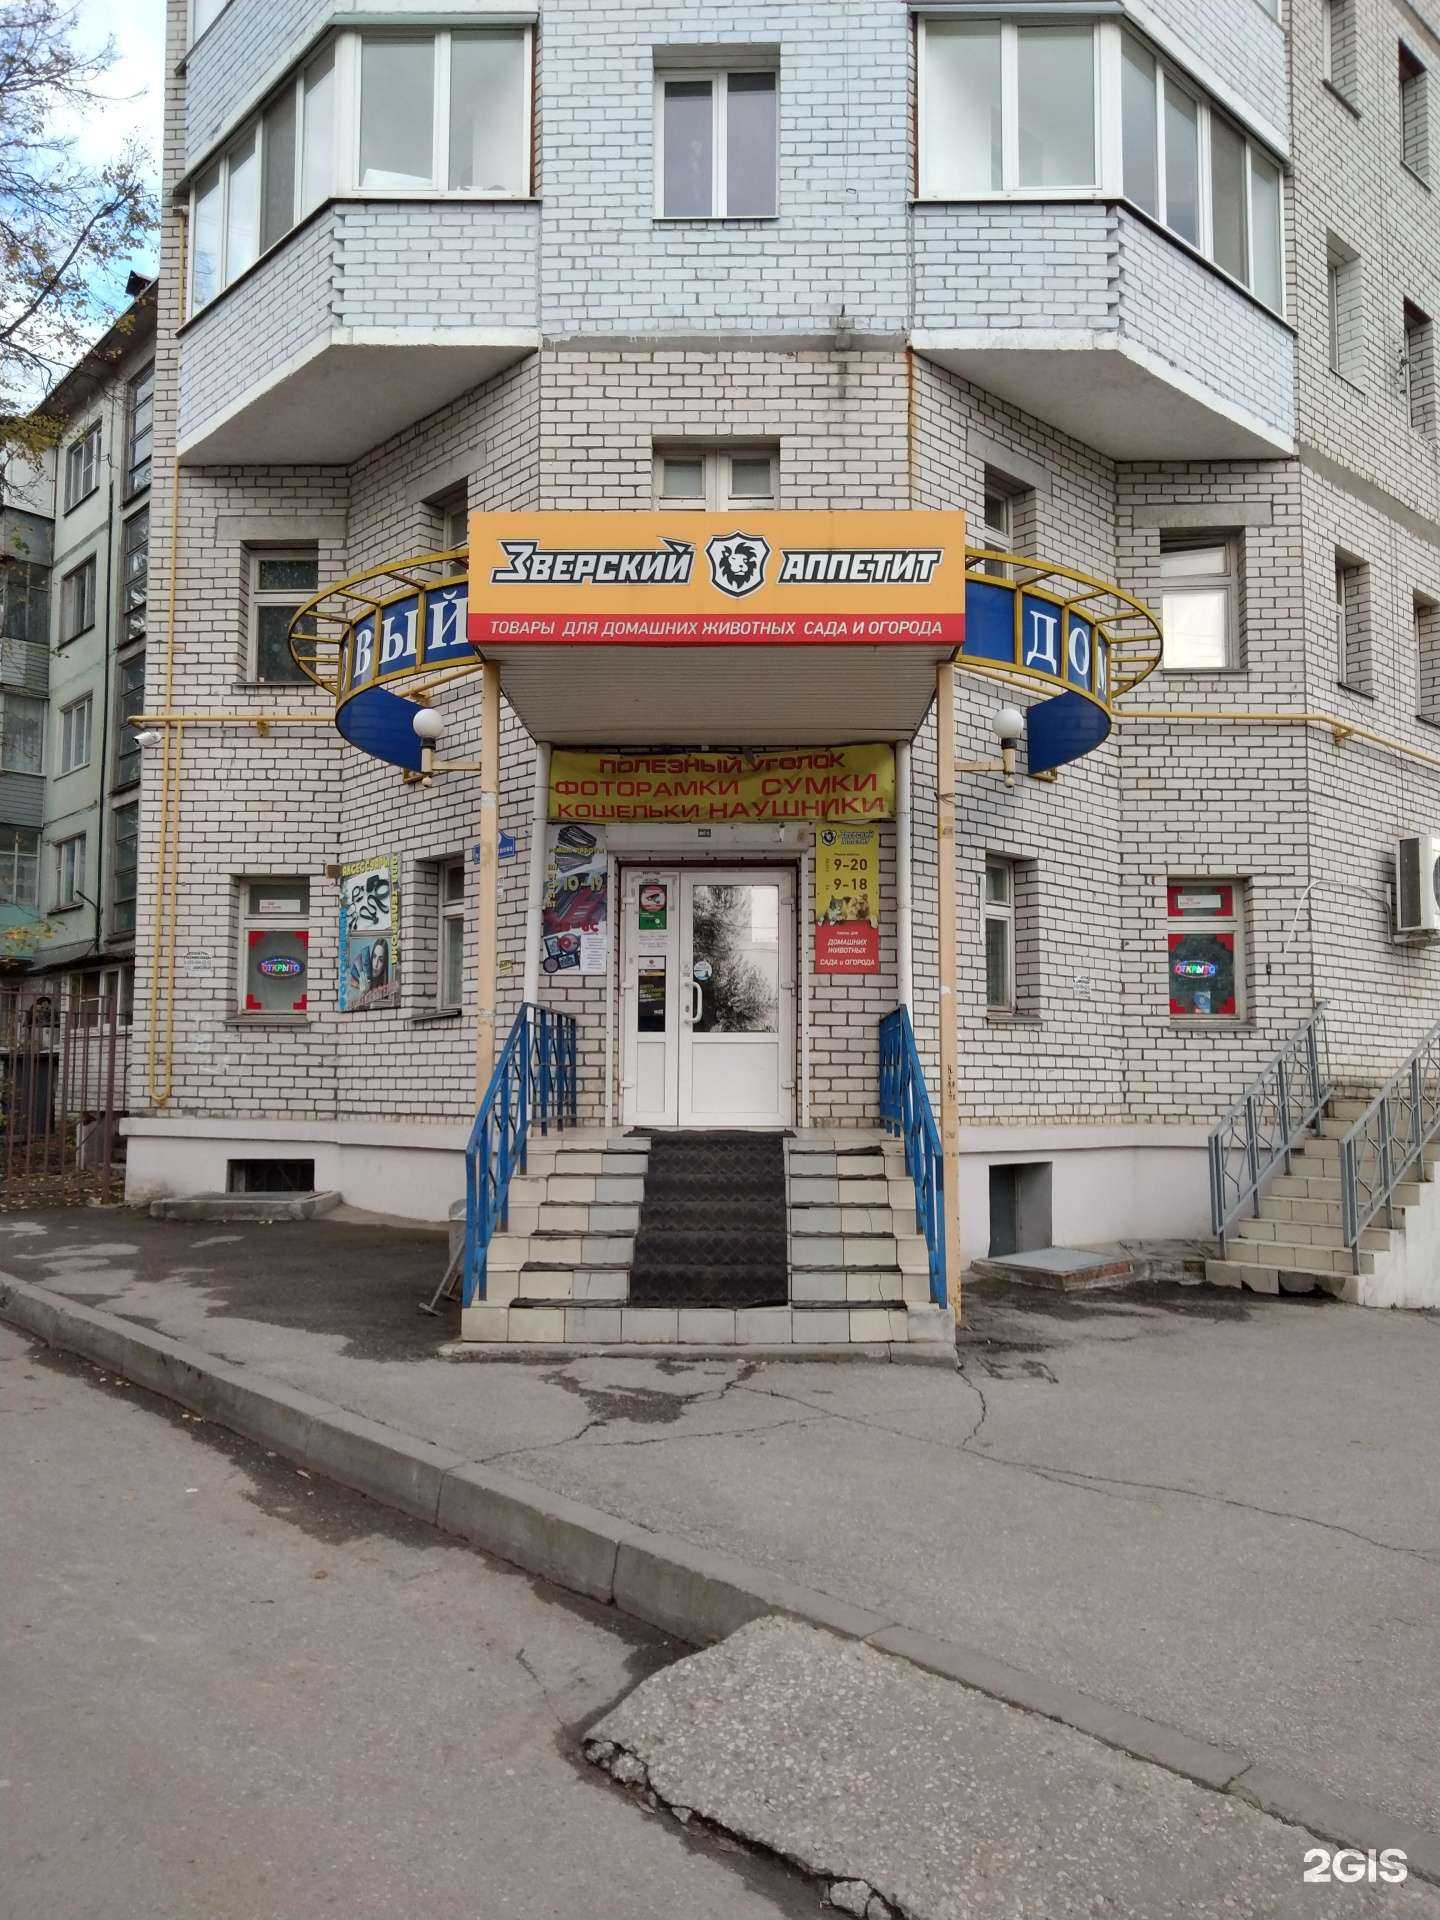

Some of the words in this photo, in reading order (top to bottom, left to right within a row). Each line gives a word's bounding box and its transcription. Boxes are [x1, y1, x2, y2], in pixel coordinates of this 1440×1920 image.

[491, 536, 695, 583] ЗВЕРСКИЙ
[778, 549, 943, 583] АППЕТИТ
[490, 620, 555, 635] ТОВАРЫ
[561, 620, 599, 637] ДЛЯ
[601, 620, 698, 637] ДОМАШНИХ
[701, 620, 796, 635] ЖИВОТНЫХ
[803, 620, 848, 637] САДА
[852, 620, 865, 635] И
[868, 620, 943, 637] ОГОРОДА
[599, 755, 743, 774] ПОЛЕЗНЫЙ
[749, 752, 846, 772] УГОЛОК
[554, 779, 739, 797] ФОТОРАМКИ
[761, 773, 877, 796] СУМКИ
[557, 803, 700, 819] КОШЕЛЬКИ
[709, 796, 884, 819] НАУШНИКИ
[833, 858, 868, 871] 9-20
[833, 878, 868, 890] 9-18
[827, 938, 868, 946] ДОМАШНИХ
[827, 946, 866, 954] ЖИВОТНЫХ
